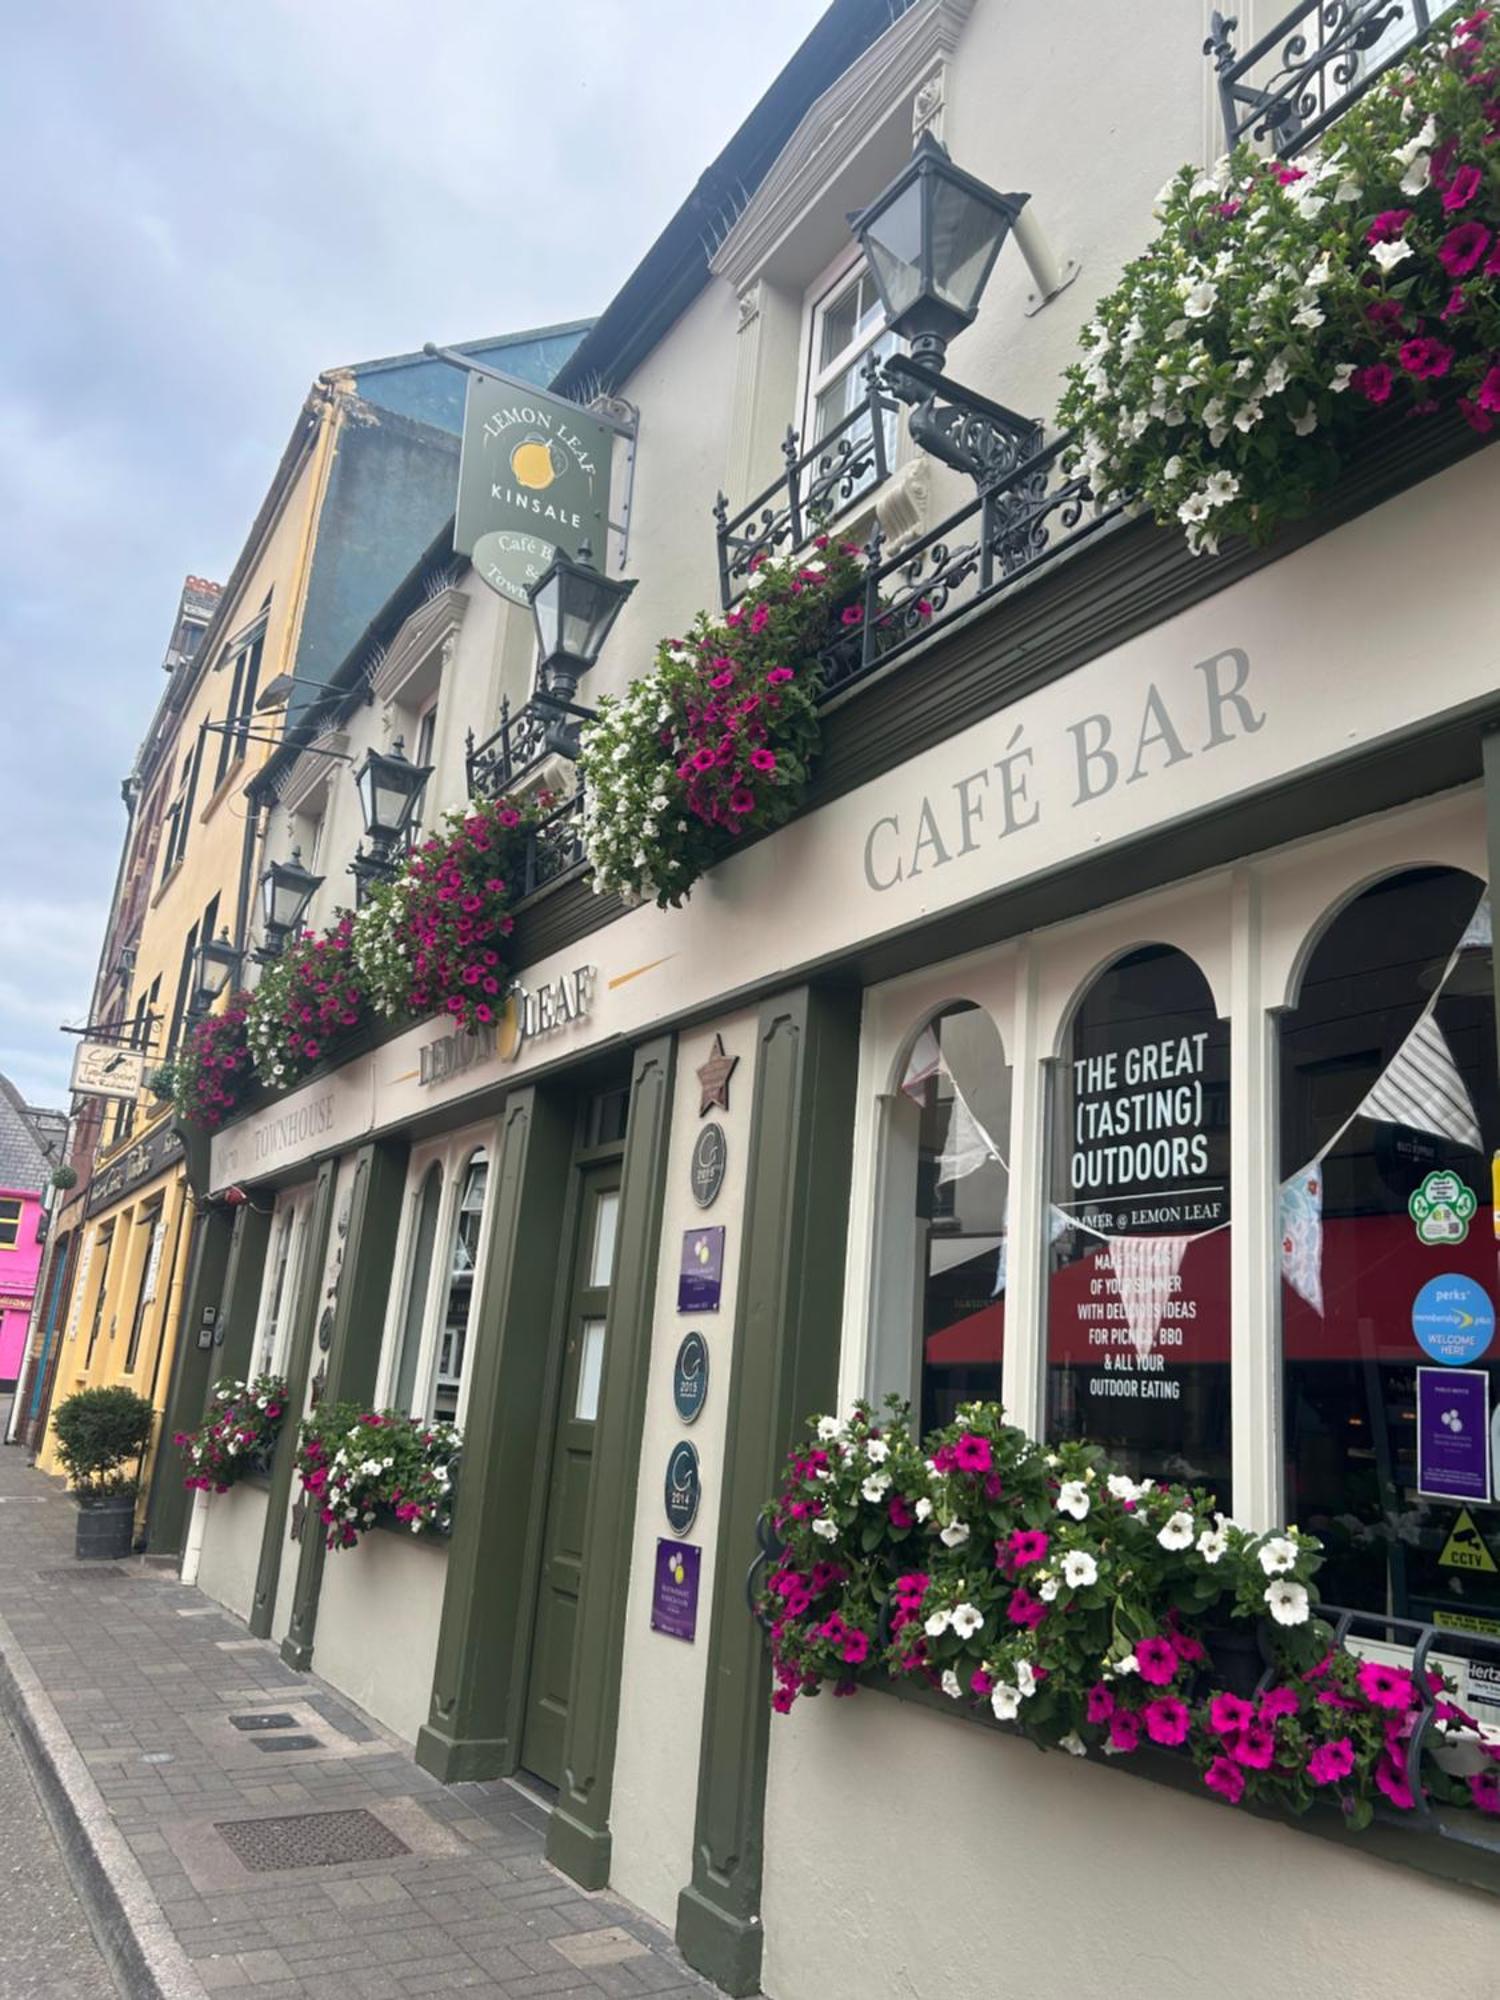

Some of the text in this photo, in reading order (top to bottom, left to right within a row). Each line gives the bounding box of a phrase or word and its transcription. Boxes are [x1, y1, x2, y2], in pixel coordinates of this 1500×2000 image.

[483, 407, 597, 475] LEMON LEAF
[491, 484, 581, 528] KINSALE
[498, 535, 536, 554] Café
[525, 564, 539, 579] &
[864, 647, 1267, 892] CAFÉ BAR
[524, 965, 598, 1036] LEAF
[1074, 1033, 1208, 1095] THE GREAT
[1077, 1080, 1202, 1144] (TASTING)
[255, 1094, 335, 1160] TOWNHOUSE
[1071, 1134, 1208, 1188] OUTDOORS
[1131, 1206, 1181, 1225] LEMON
[1185, 1203, 1221, 1220] LEAF
[1090, 1279, 1103, 1295] OF
[1077, 1303, 1104, 1320] WITH
[1163, 1301, 1196, 1319] IDEAS
[1089, 1328, 1109, 1345] FOR
[1160, 1327, 1183, 1345] BBQ
[1429, 1333, 1477, 1346] WELCOME
[1441, 1345, 1465, 1355] HERE
[1104, 1353, 1164, 1371] & ALL YOUR
[1090, 1378, 1180, 1399] OUTDOOR EATING
[1451, 1551, 1484, 1567] CCTV
